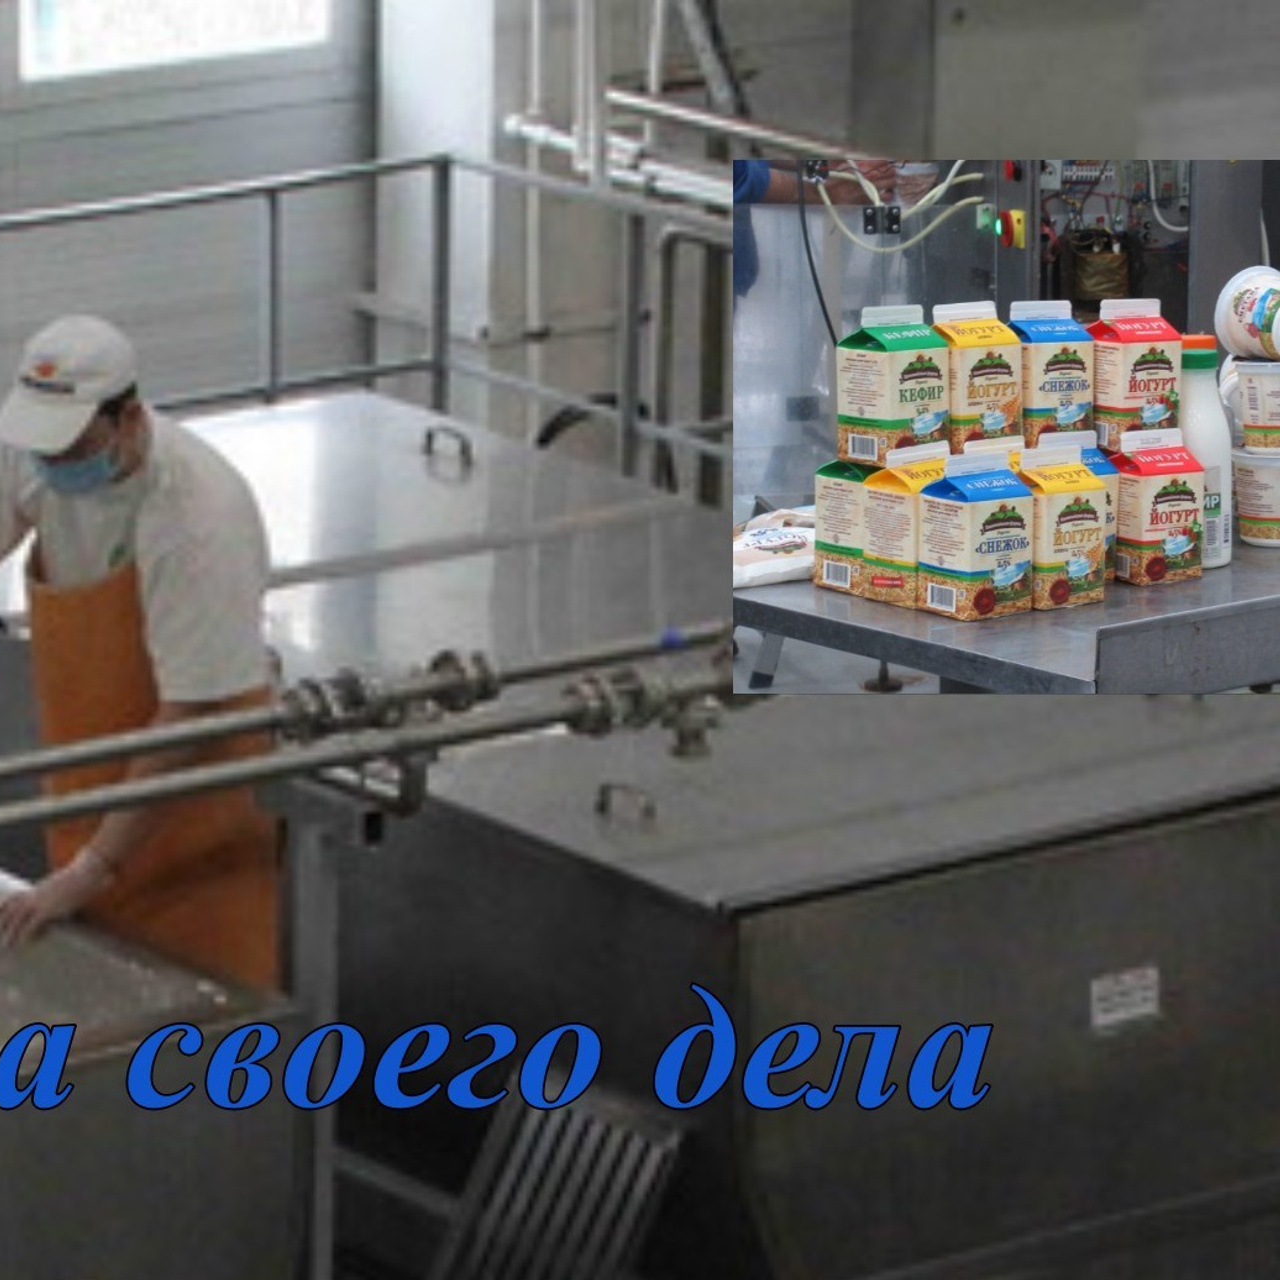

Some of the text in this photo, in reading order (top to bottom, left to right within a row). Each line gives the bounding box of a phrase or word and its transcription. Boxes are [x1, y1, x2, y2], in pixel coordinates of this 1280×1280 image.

[967, 381, 1017, 399] ЙОГУРТ
[1128, 375, 1177, 393] ЙОГУРТ
[899, 386, 944, 403] КЕФИР
[1149, 508, 1199, 525] ЙОГУРТ
[1053, 527, 1101, 547] ЙОГУРТ
